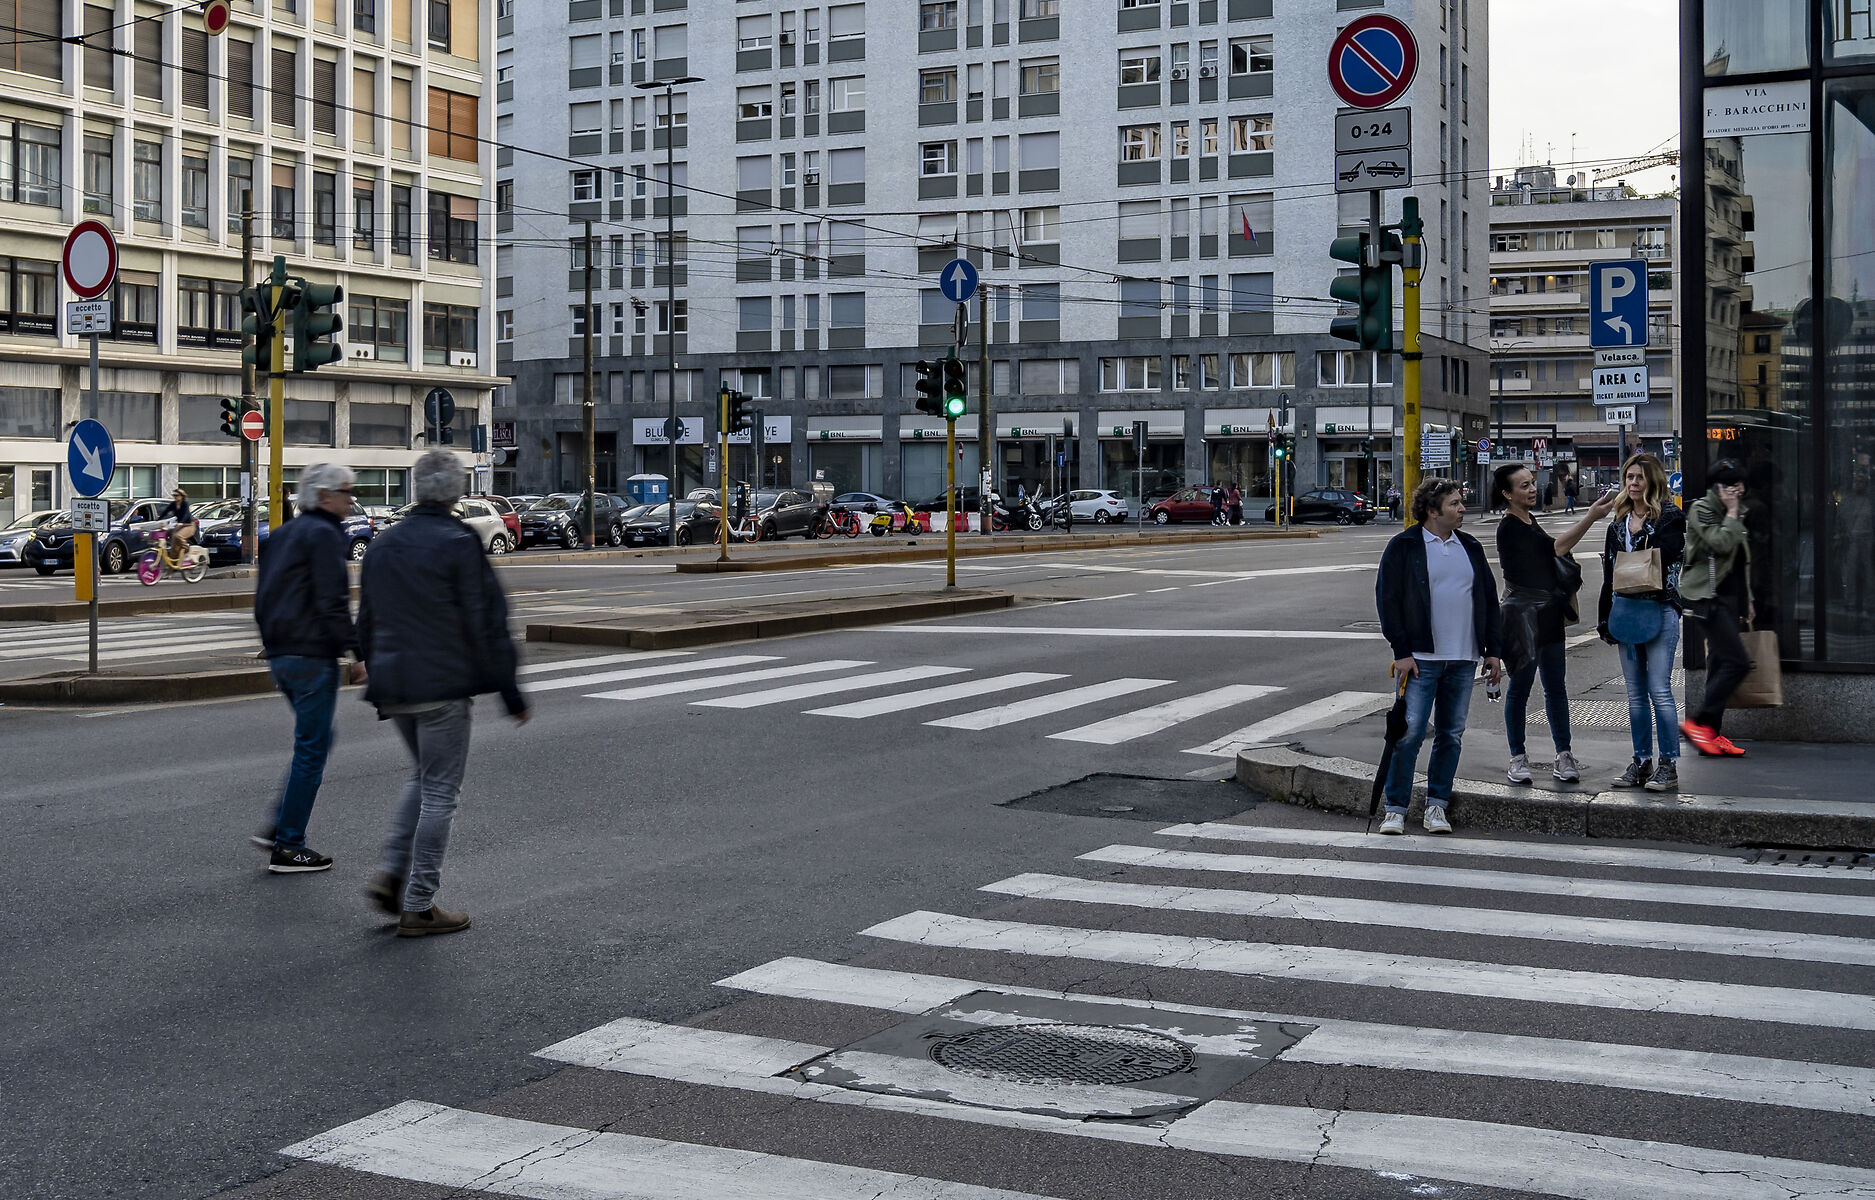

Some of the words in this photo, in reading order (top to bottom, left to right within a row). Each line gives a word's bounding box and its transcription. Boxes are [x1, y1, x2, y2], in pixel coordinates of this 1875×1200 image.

[1745, 88, 1767, 97] VIA
[1707, 108, 1717, 117] F.
[1725, 102, 1807, 116] BARACCHINI
[1351, 122, 1393, 139] 0-24
[1601, 267, 1636, 313] P
[75, 303, 102, 312] eccetto
[1599, 373, 1627, 386] AREA
[1634, 372, 1641, 384] C
[1596, 392, 1614, 400] TICKET
[1618, 410, 1632, 420] WASH
[493, 428, 512, 440] ELASCA
[645, 427, 668, 438] BLU
[1533, 439, 1546, 449] M
[77, 502, 100, 510] eccetto
